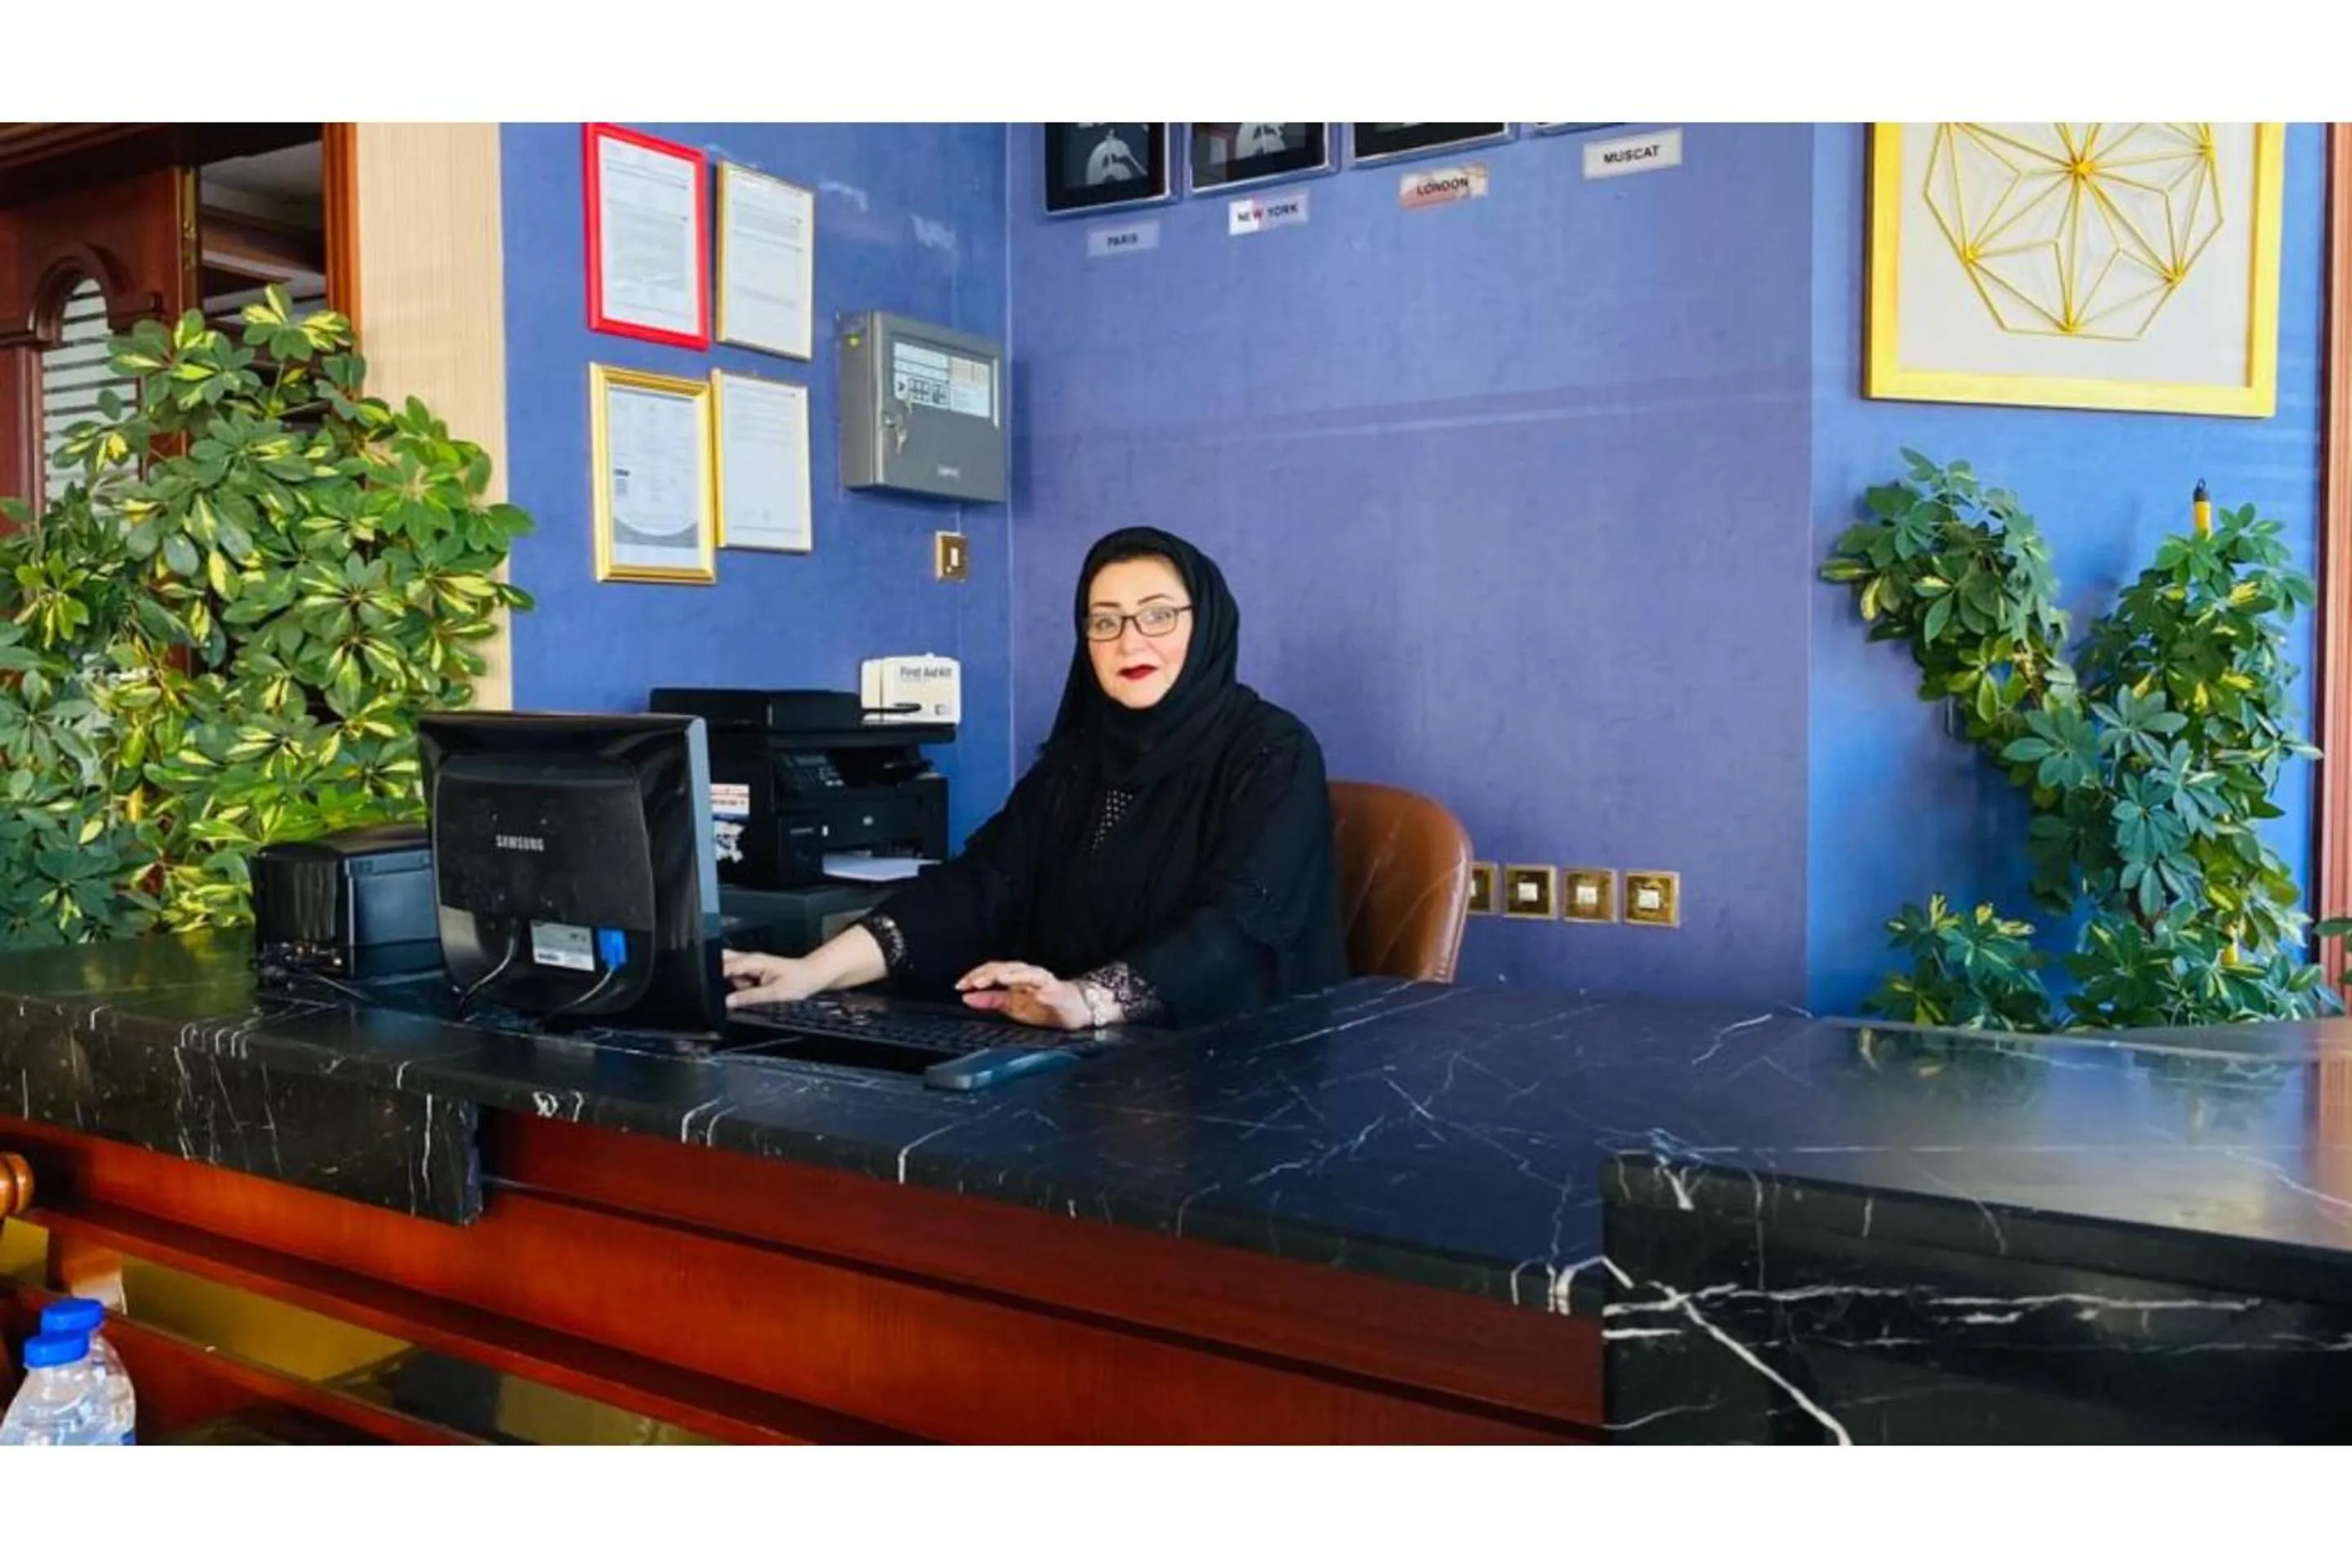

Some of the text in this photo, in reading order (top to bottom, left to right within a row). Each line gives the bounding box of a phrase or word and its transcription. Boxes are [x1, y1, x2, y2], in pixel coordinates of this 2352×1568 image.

[1603, 144, 1660, 164] MUSCAT
[1416, 176, 1469, 197] LONDON
[1237, 203, 1298, 222] NEW YORK
[1107, 232, 1138, 247] PARIS
[495, 834, 545, 852] SAMSUNG
